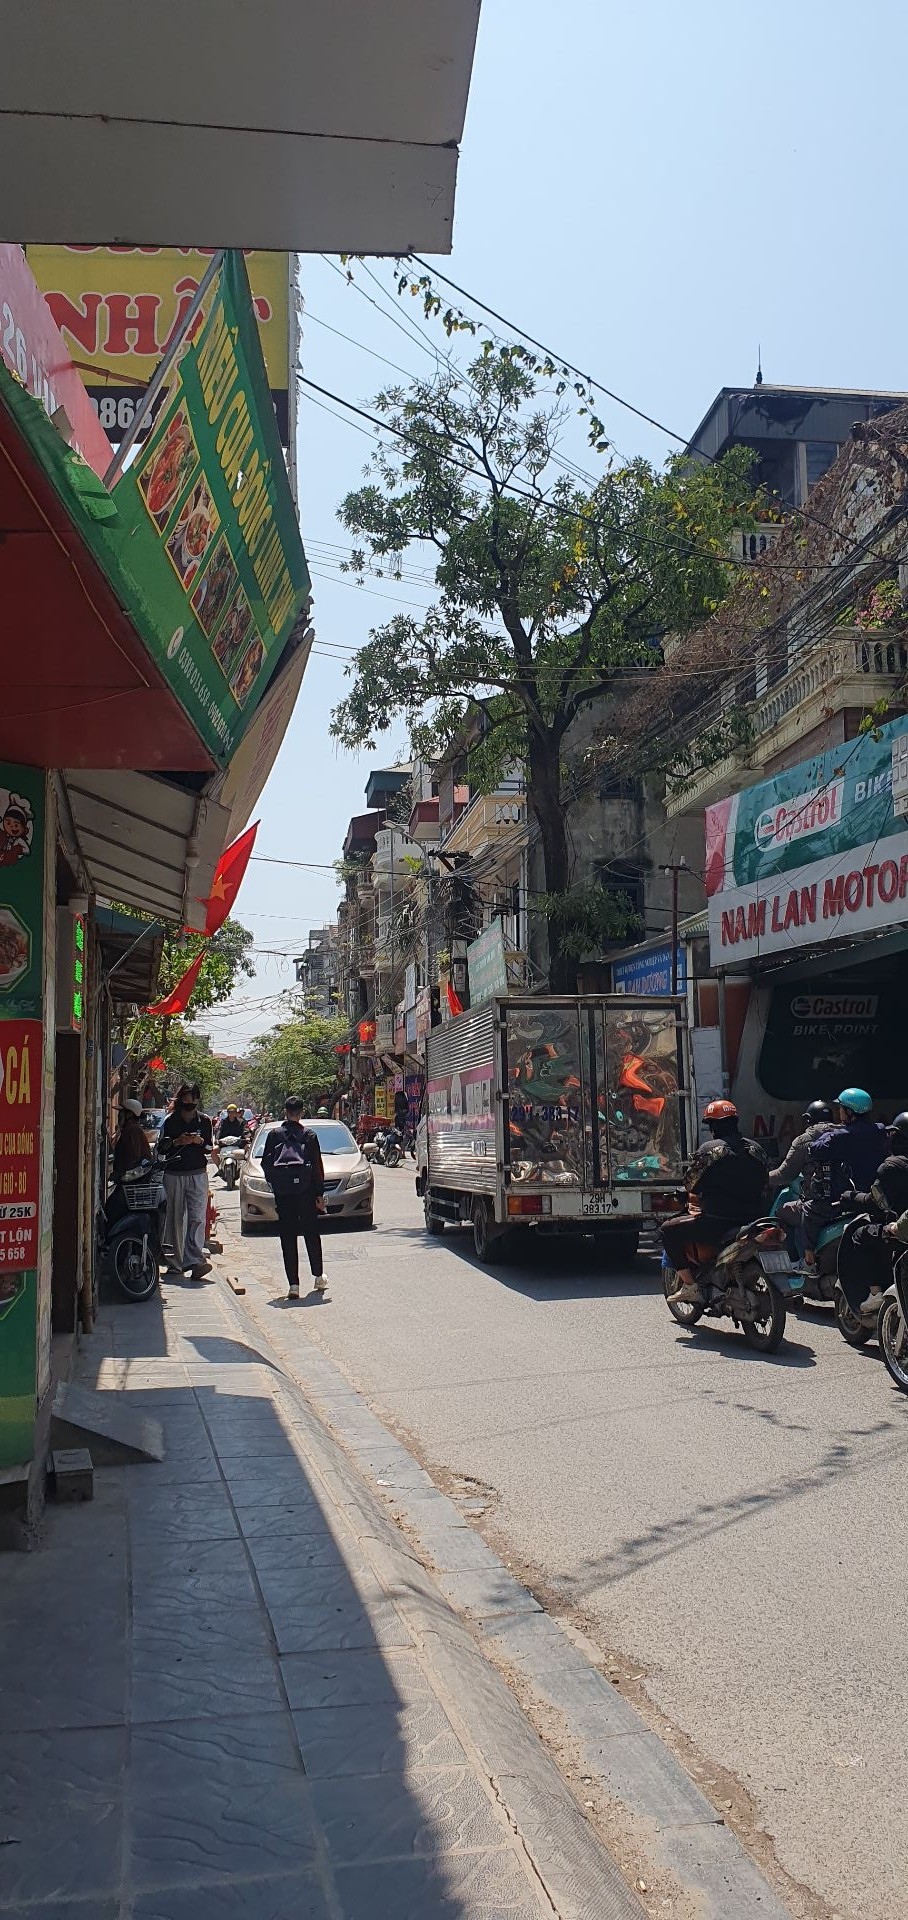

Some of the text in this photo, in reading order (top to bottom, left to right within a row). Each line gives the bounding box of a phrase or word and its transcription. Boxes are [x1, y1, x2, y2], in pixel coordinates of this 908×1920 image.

[216, 390, 254, 491] CUA
[774, 772, 892, 842] Castrol BIKE
[721, 899, 766, 946] NAM
[771, 883, 817, 933] LAN
[812, 997, 873, 1016] Castrol
[794, 1023, 879, 1036] BIKE POINT
[5, 1034, 31, 1105] CÁ
[753, 1114, 796, 1138] NA
[589, 1193, 606, 1204] 29H
[9, 1206, 32, 1218] 25K
[583, 1203, 612, 1214] 383.17
[9, 1227, 32, 1245] LỘN
[8, 1246, 25, 1261] 658
